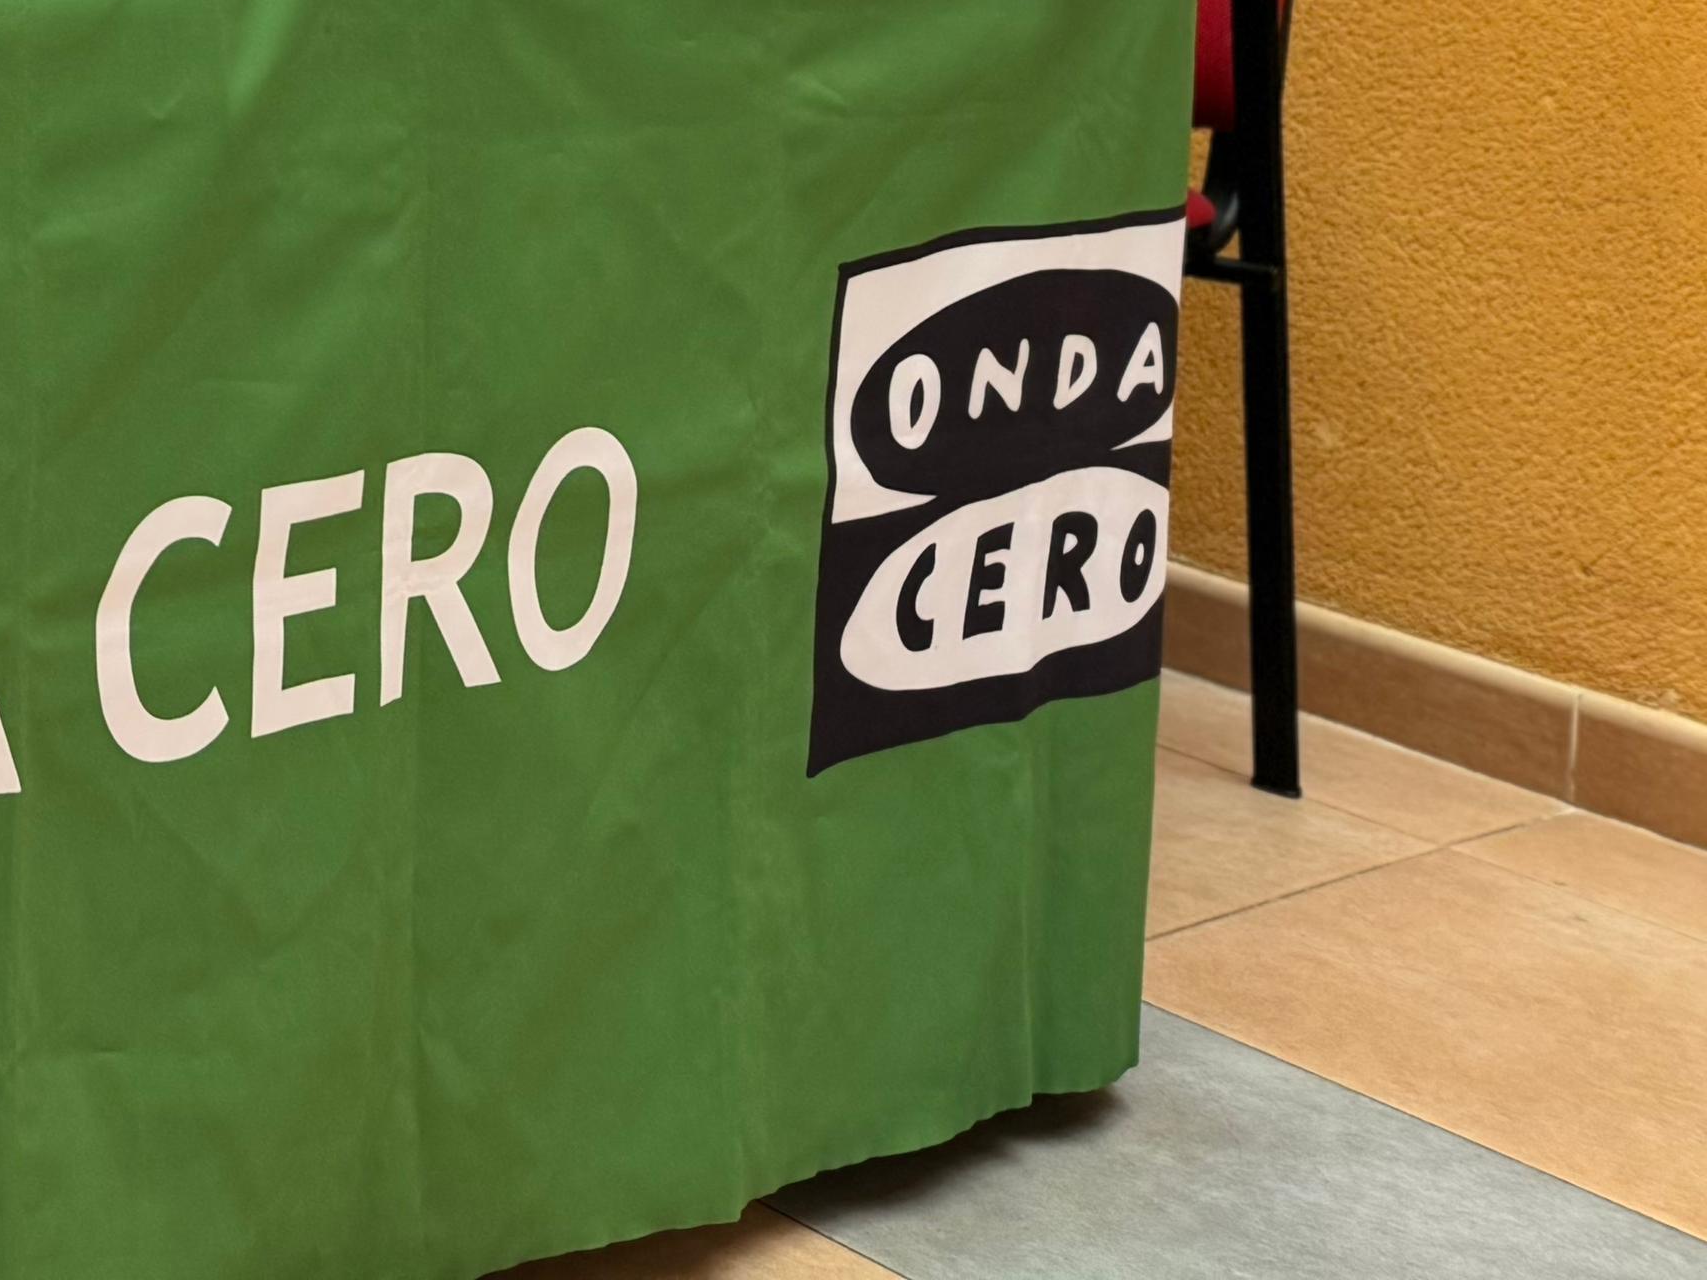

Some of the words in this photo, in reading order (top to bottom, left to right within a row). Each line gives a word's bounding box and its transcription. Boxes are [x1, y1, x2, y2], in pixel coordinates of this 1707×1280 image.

[888, 322, 1164, 450] ONDA
[94, 426, 638, 764] CERO
[895, 507, 1157, 652] CERO
